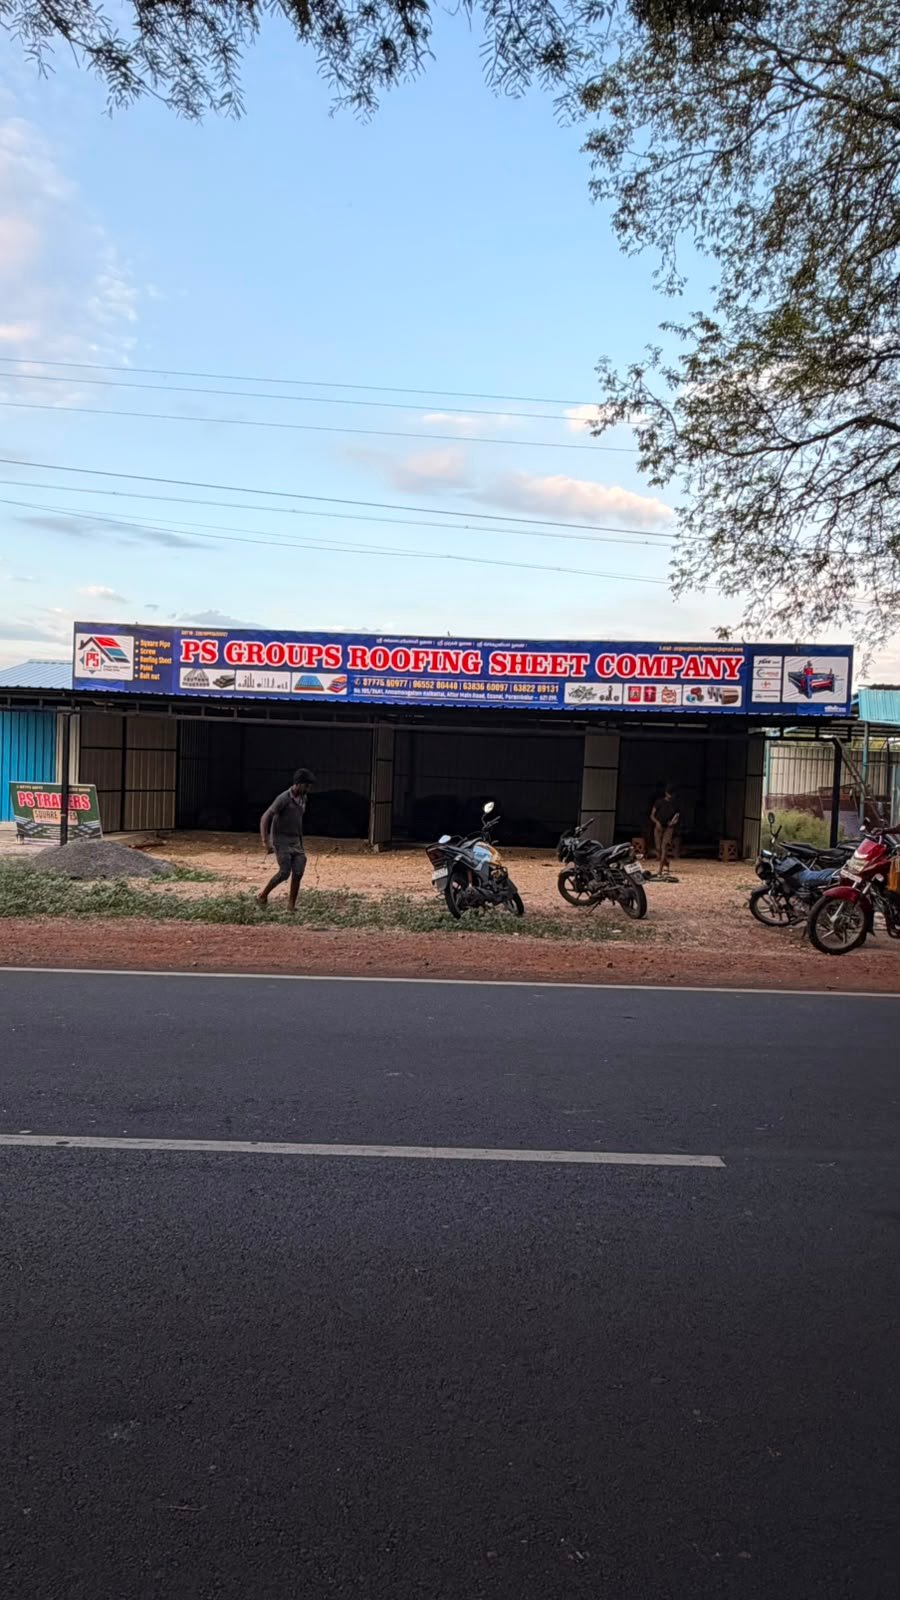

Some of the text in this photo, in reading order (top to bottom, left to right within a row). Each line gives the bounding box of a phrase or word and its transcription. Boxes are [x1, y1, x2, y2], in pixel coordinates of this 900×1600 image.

[140, 640, 171, 649] Square Pipe
[86, 652, 99, 667] PS
[180, 640, 744, 679] PS GROUPS ROOFING SHEET COMPANY
[18, 791, 90, 810] PS TRAERS
